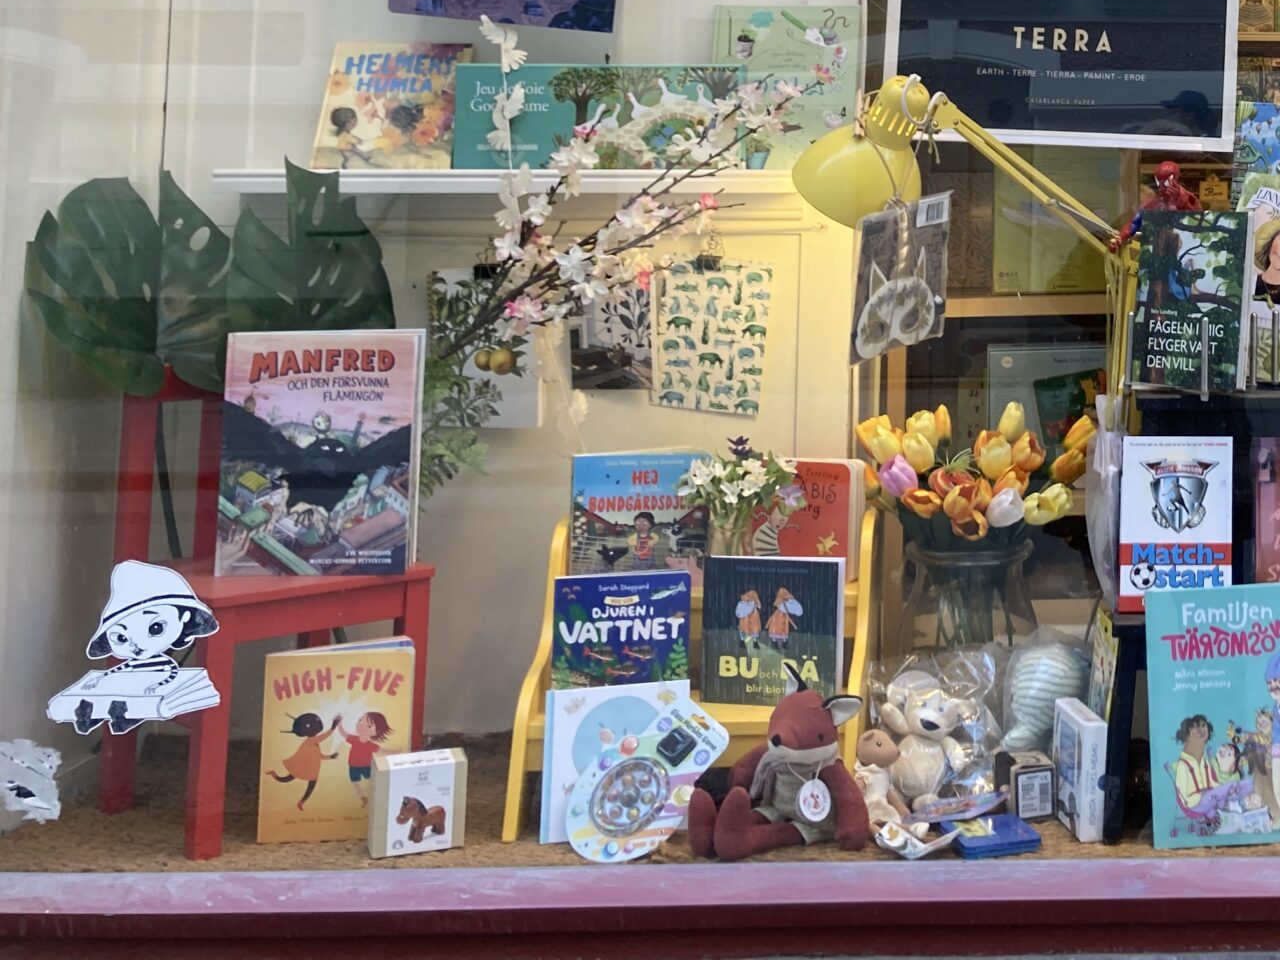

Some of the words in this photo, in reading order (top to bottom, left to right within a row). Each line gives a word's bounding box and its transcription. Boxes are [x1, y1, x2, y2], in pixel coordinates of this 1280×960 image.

[1012, 25, 1113, 54] TERRA
[976, 67, 1004, 76] EARTH
[1013, 68, 1038, 78] TERRE
[1046, 70, 1076, 79] TIERRA
[1083, 71, 1116, 81] PAMINT
[1124, 73, 1146, 82] ERDE
[356, 76, 433, 95] HUMLA
[1149, 316, 1193, 336] FÅGELN
[1147, 336, 1188, 354] FLYGER
[1189, 340, 1218, 355] VAT
[249, 348, 396, 385] MANFRED
[1146, 354, 1171, 370] DEN
[1172, 356, 1196, 372] VILL
[287, 379, 308, 391] OCH
[310, 377, 330, 389] DEN
[323, 390, 384, 403] FLAMINGON
[631, 469, 659, 486] HEJ
[1131, 543, 1226, 566] Match-
[1154, 564, 1224, 588] start
[1181, 601, 1273, 628] Familjen
[558, 617, 686, 645] VATTNET
[718, 655, 760, 679] BU
[759, 668, 778, 680] och
